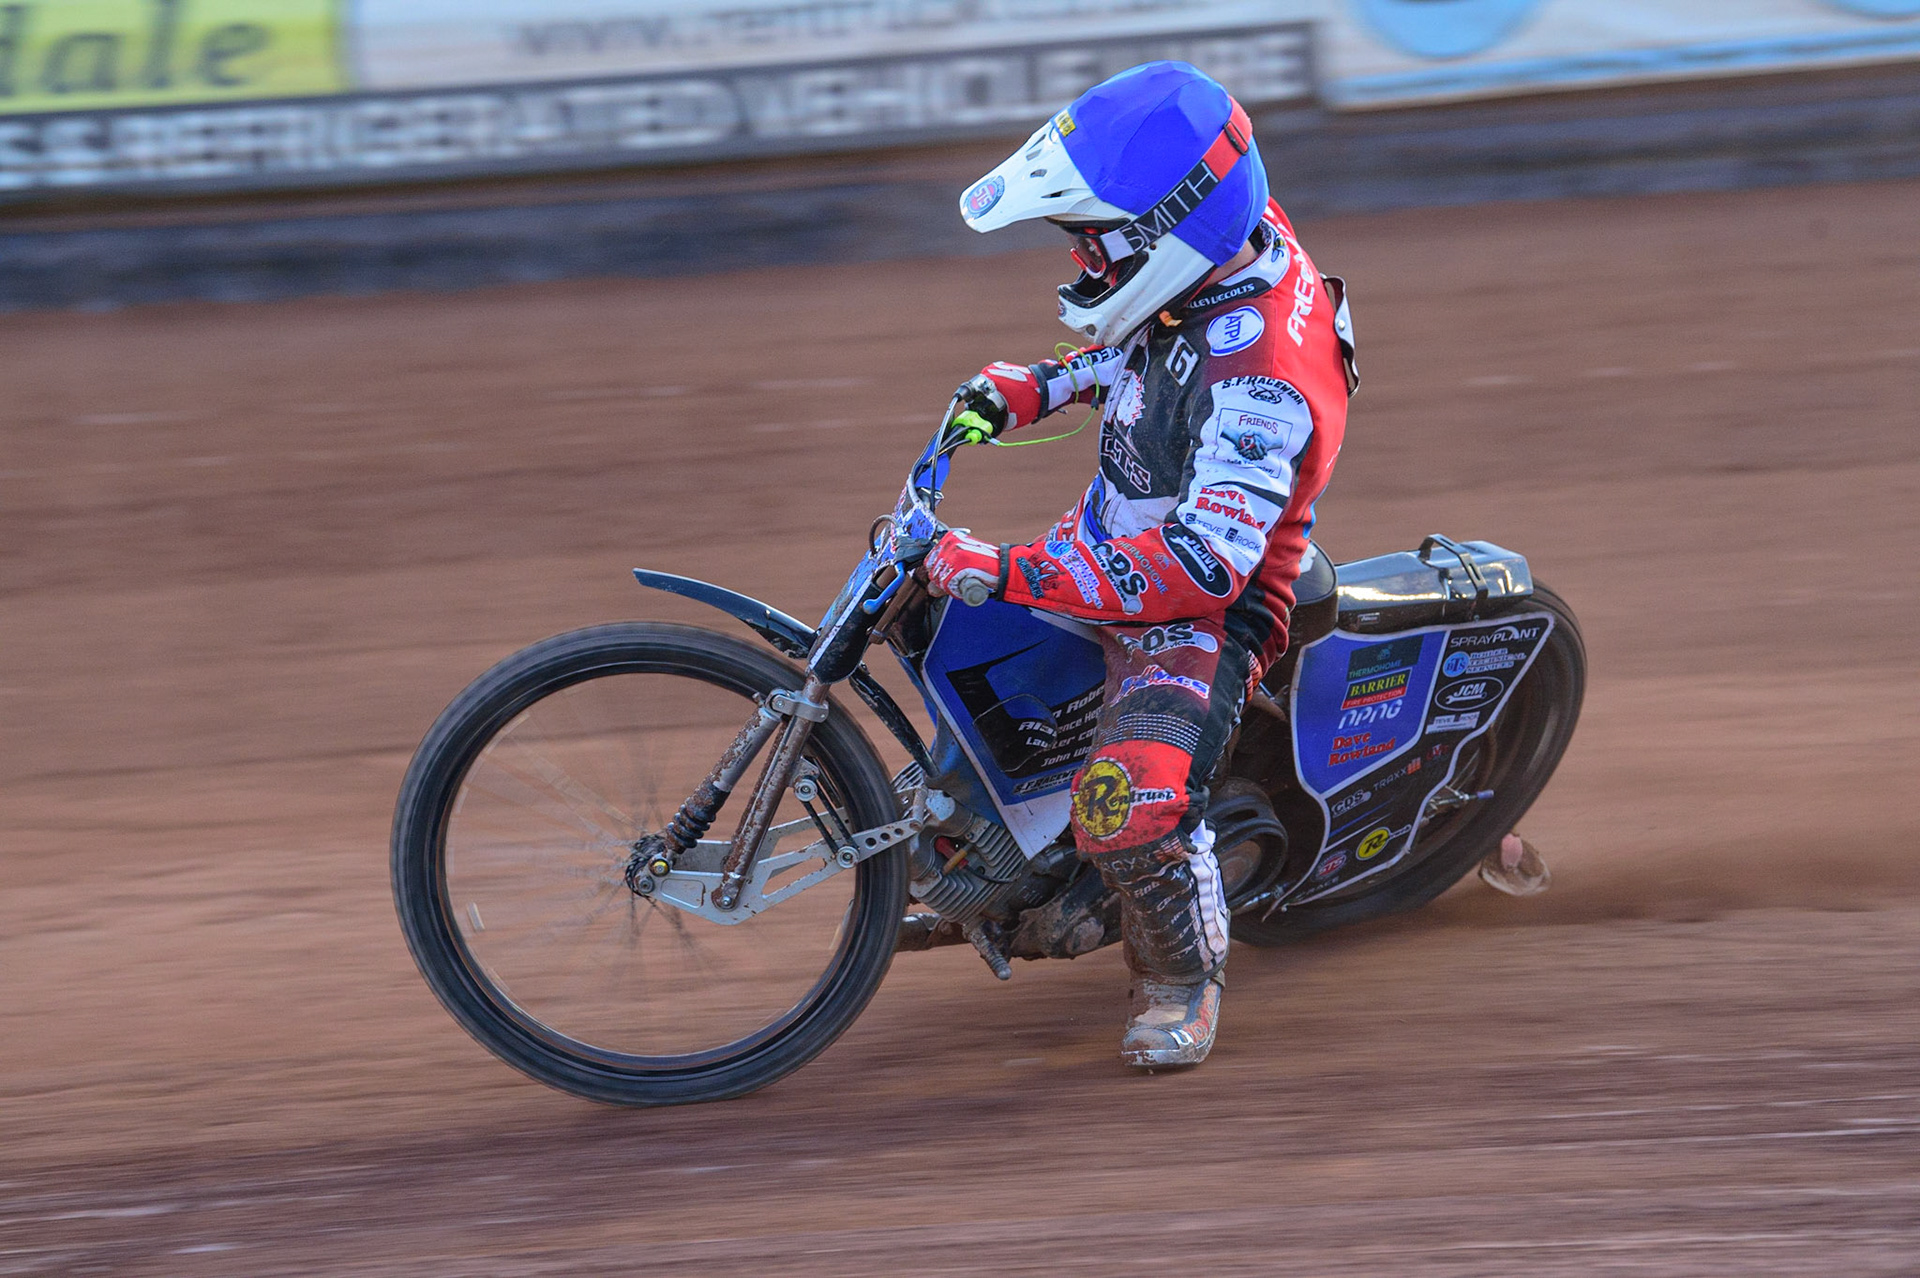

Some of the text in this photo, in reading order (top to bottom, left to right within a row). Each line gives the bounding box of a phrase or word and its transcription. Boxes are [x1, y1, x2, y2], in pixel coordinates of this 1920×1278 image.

[1120, 161, 1220, 252] SMITH
[1238, 414, 1279, 435] FRIENDS
[1225, 527, 1263, 554] BROCK
[1450, 626, 1541, 648] SPRAYPLANT
[1350, 674, 1405, 696] BARRIER
[1362, 689, 1403, 703] PROTECTION
[1454, 682, 1486, 697] JCM
[1328, 738, 1395, 766] Rowland
[1333, 732, 1371, 750] Dave
